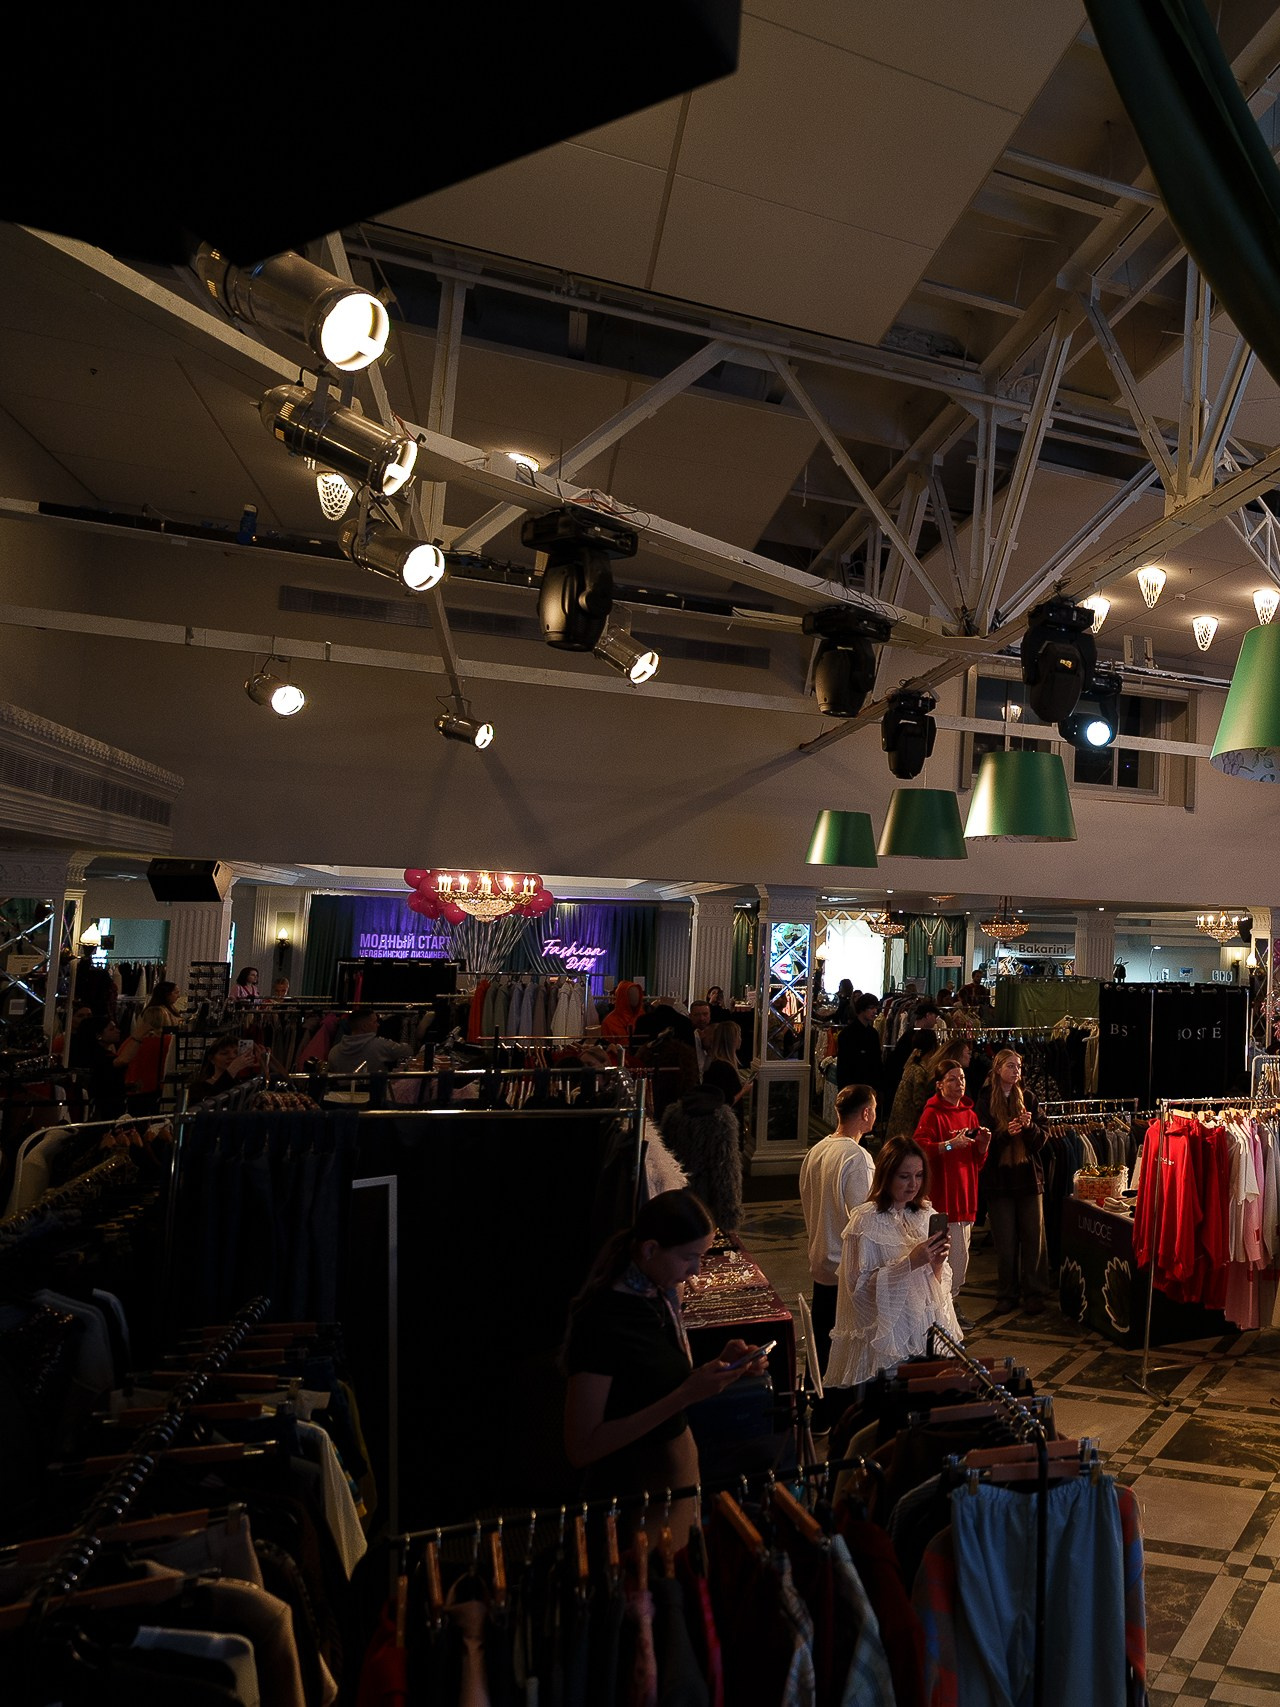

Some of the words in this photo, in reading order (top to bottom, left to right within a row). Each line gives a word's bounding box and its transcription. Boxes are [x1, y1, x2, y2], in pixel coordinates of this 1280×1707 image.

[360, 933, 415, 949] МОДНЫЙ
[542, 940, 607, 958] Fashion
[1019, 944, 1067, 954] Bakarini
[566, 957, 597, 971] DAY
